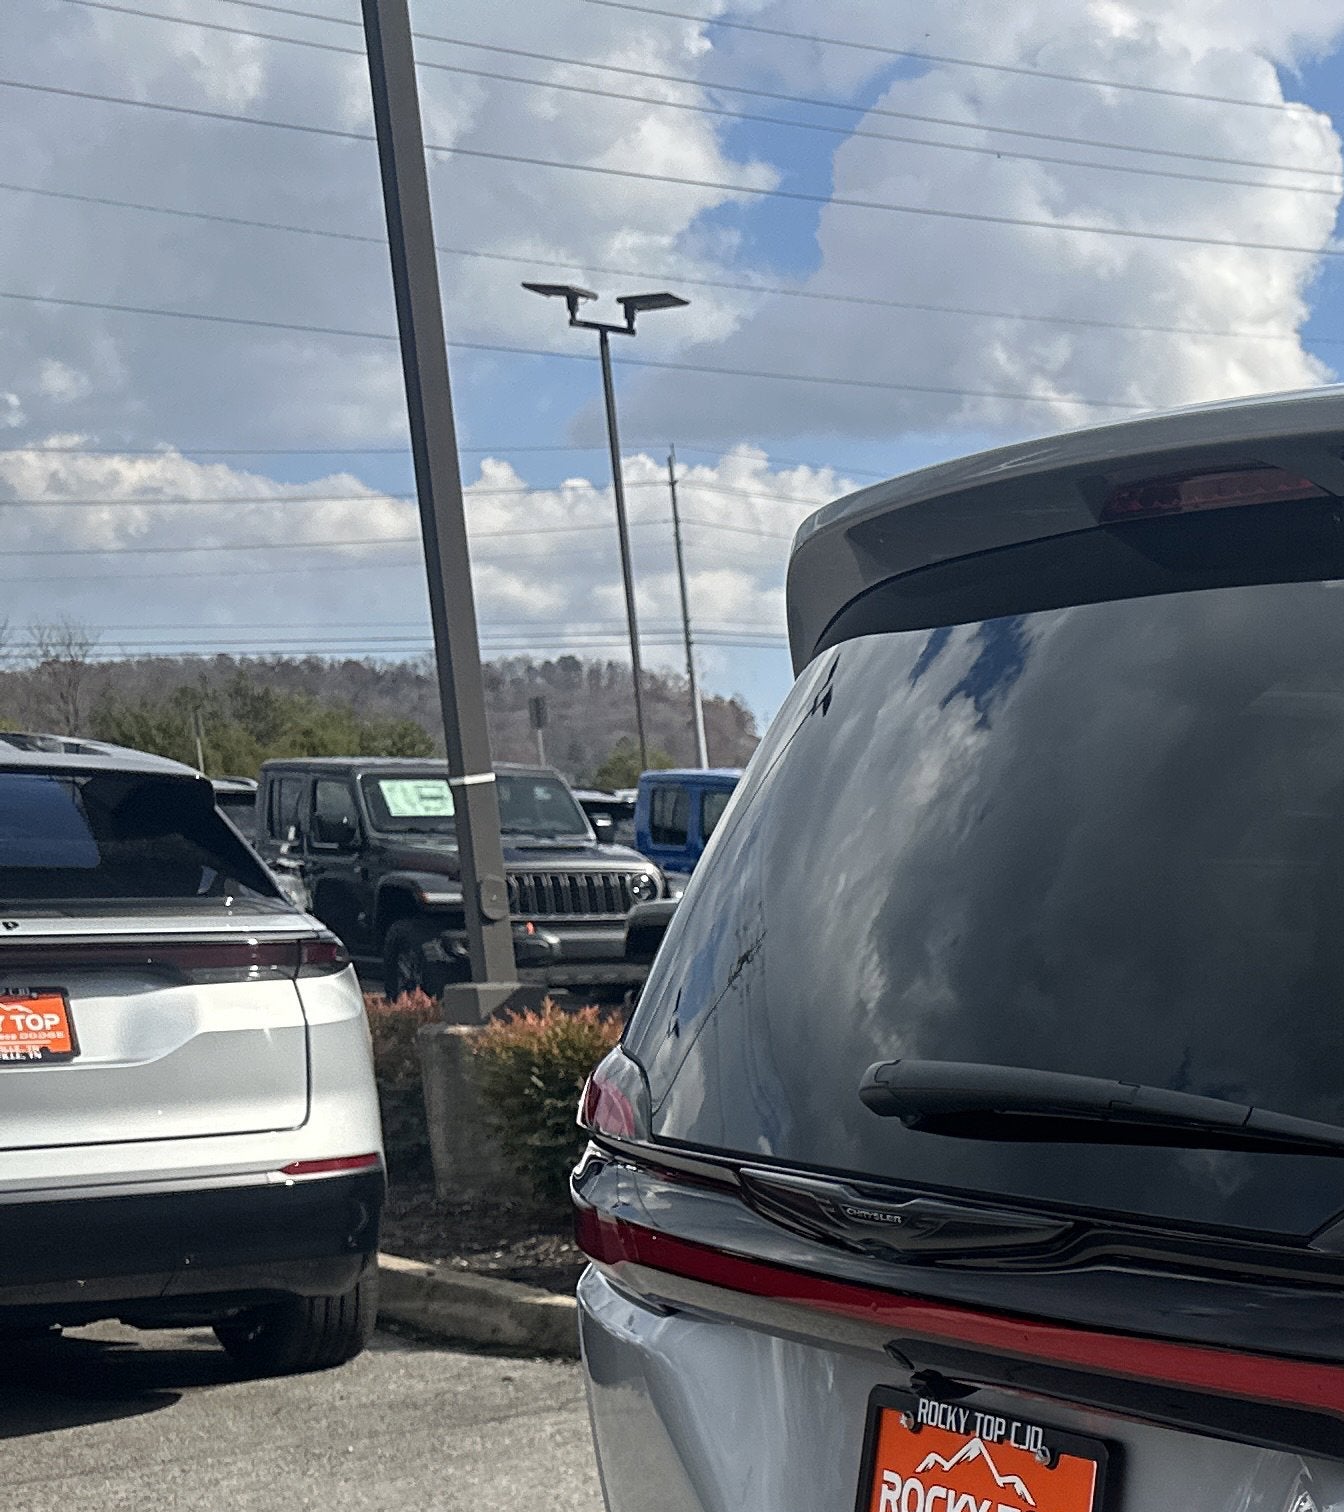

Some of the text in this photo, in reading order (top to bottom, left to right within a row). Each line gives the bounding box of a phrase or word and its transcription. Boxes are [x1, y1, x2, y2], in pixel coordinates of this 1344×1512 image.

[10, 1014, 60, 1031] TOP
[917, 1397, 970, 1434] ROCKY
[975, 1411, 1006, 1442] TOP
